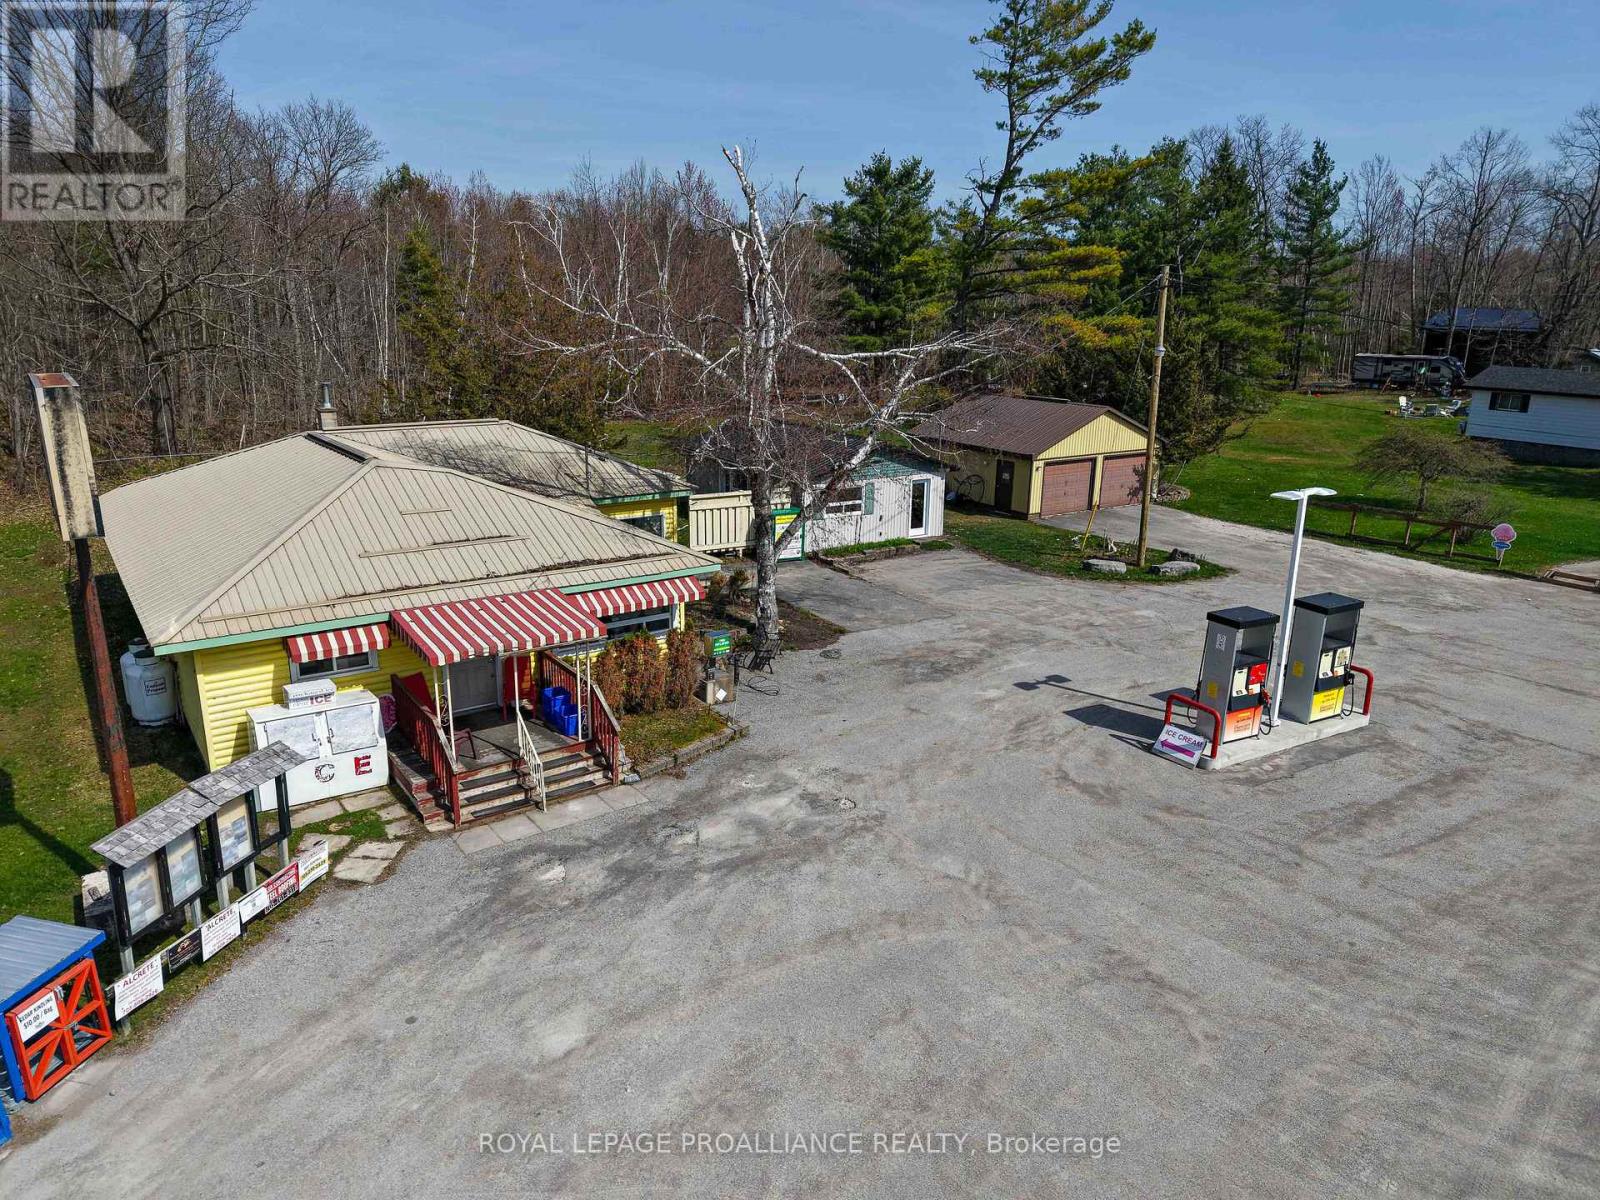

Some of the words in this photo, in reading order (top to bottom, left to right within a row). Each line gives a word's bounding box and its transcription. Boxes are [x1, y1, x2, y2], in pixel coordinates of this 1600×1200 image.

[309, 694, 332, 705] ICE
[1165, 729, 1178, 739] ICE
[1178, 733, 1203, 748] CREAM
